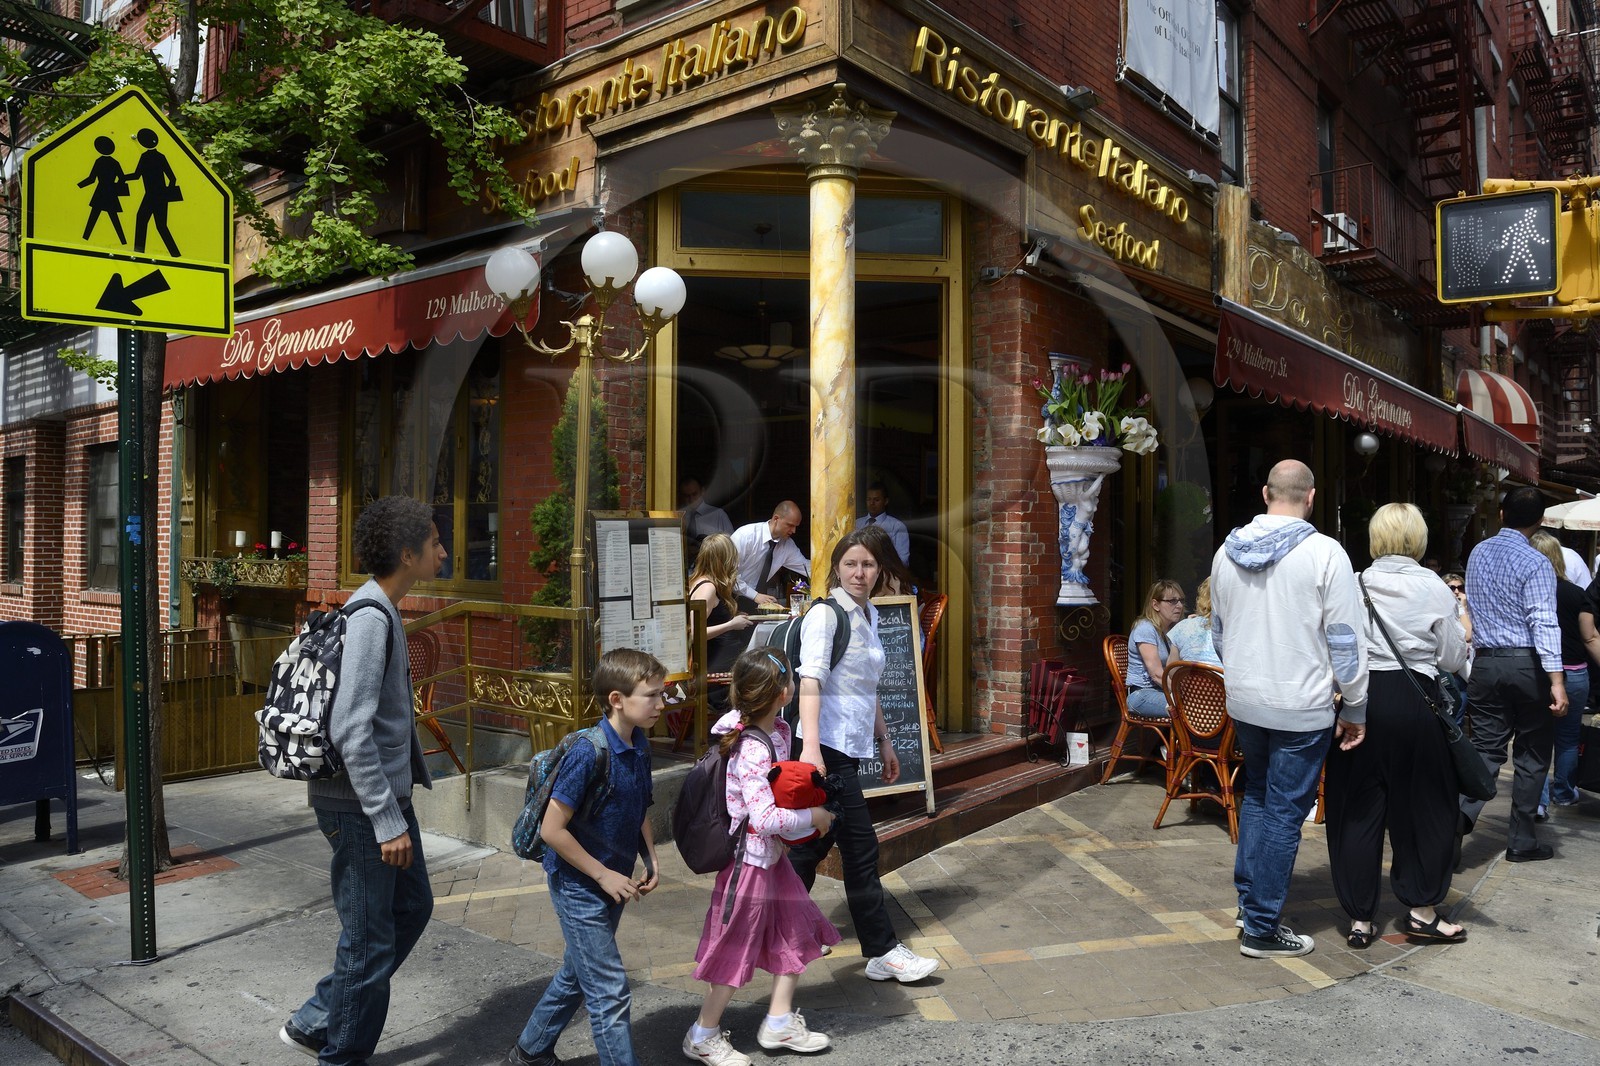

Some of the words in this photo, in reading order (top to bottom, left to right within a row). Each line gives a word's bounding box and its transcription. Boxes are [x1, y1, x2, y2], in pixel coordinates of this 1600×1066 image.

[1154, 25, 1163, 36] of
[491, 58, 653, 146] storante
[656, 6, 807, 94] Italiano
[910, 26, 1098, 170] Ristorante
[1098, 138, 1189, 224] Italiano
[482, 156, 580, 214] Sfood
[1077, 204, 1160, 271] Seafood
[425, 299, 447, 320] 129
[448, 290, 506, 316] Mulberry
[221, 328, 254, 368] Da
[257, 318, 356, 371] Gennaro
[1226, 336, 1242, 360] 129
[1241, 343, 1278, 379] Mulberry
[1278, 356, 1288, 379] St.
[1344, 372, 1365, 412] Da
[1367, 378, 1413, 433] Gennaro
[877, 608, 907, 626] pecial
[882, 633, 908, 646] NICOTTI
[891, 736, 919, 750] PIZZA
[857, 761, 884, 776] ALAD
